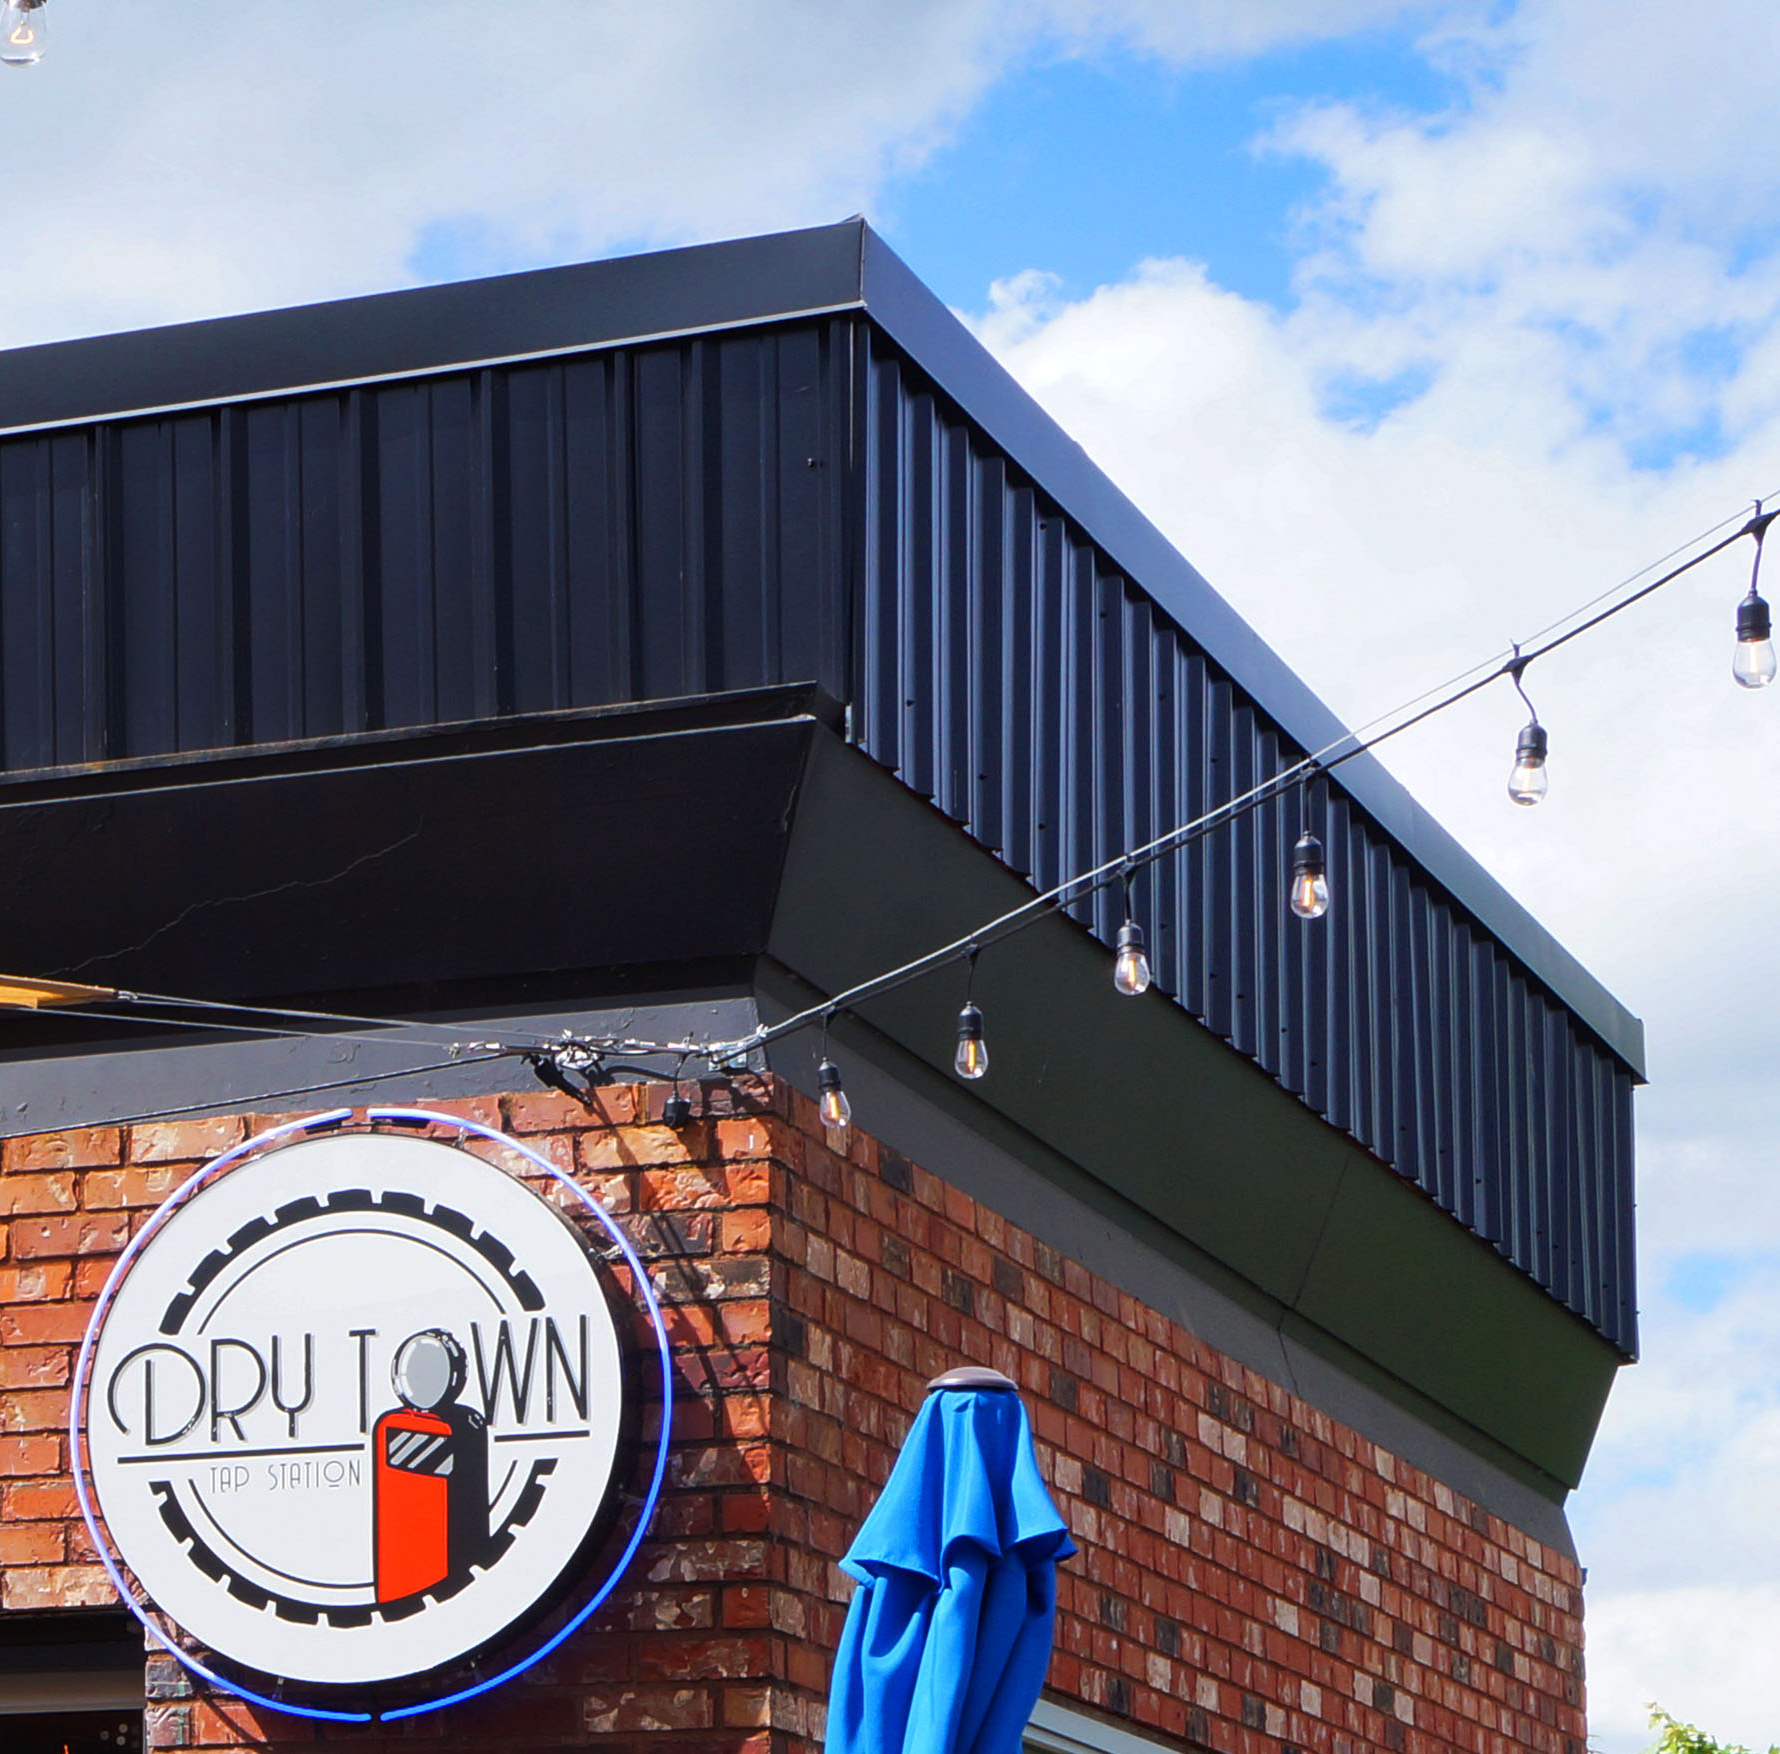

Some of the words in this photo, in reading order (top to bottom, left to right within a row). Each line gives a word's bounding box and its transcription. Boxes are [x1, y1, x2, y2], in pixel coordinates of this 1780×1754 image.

[108, 1333, 315, 1448] DRY
[209, 1465, 250, 1495] TAP
[268, 1458, 362, 1491] STATION
